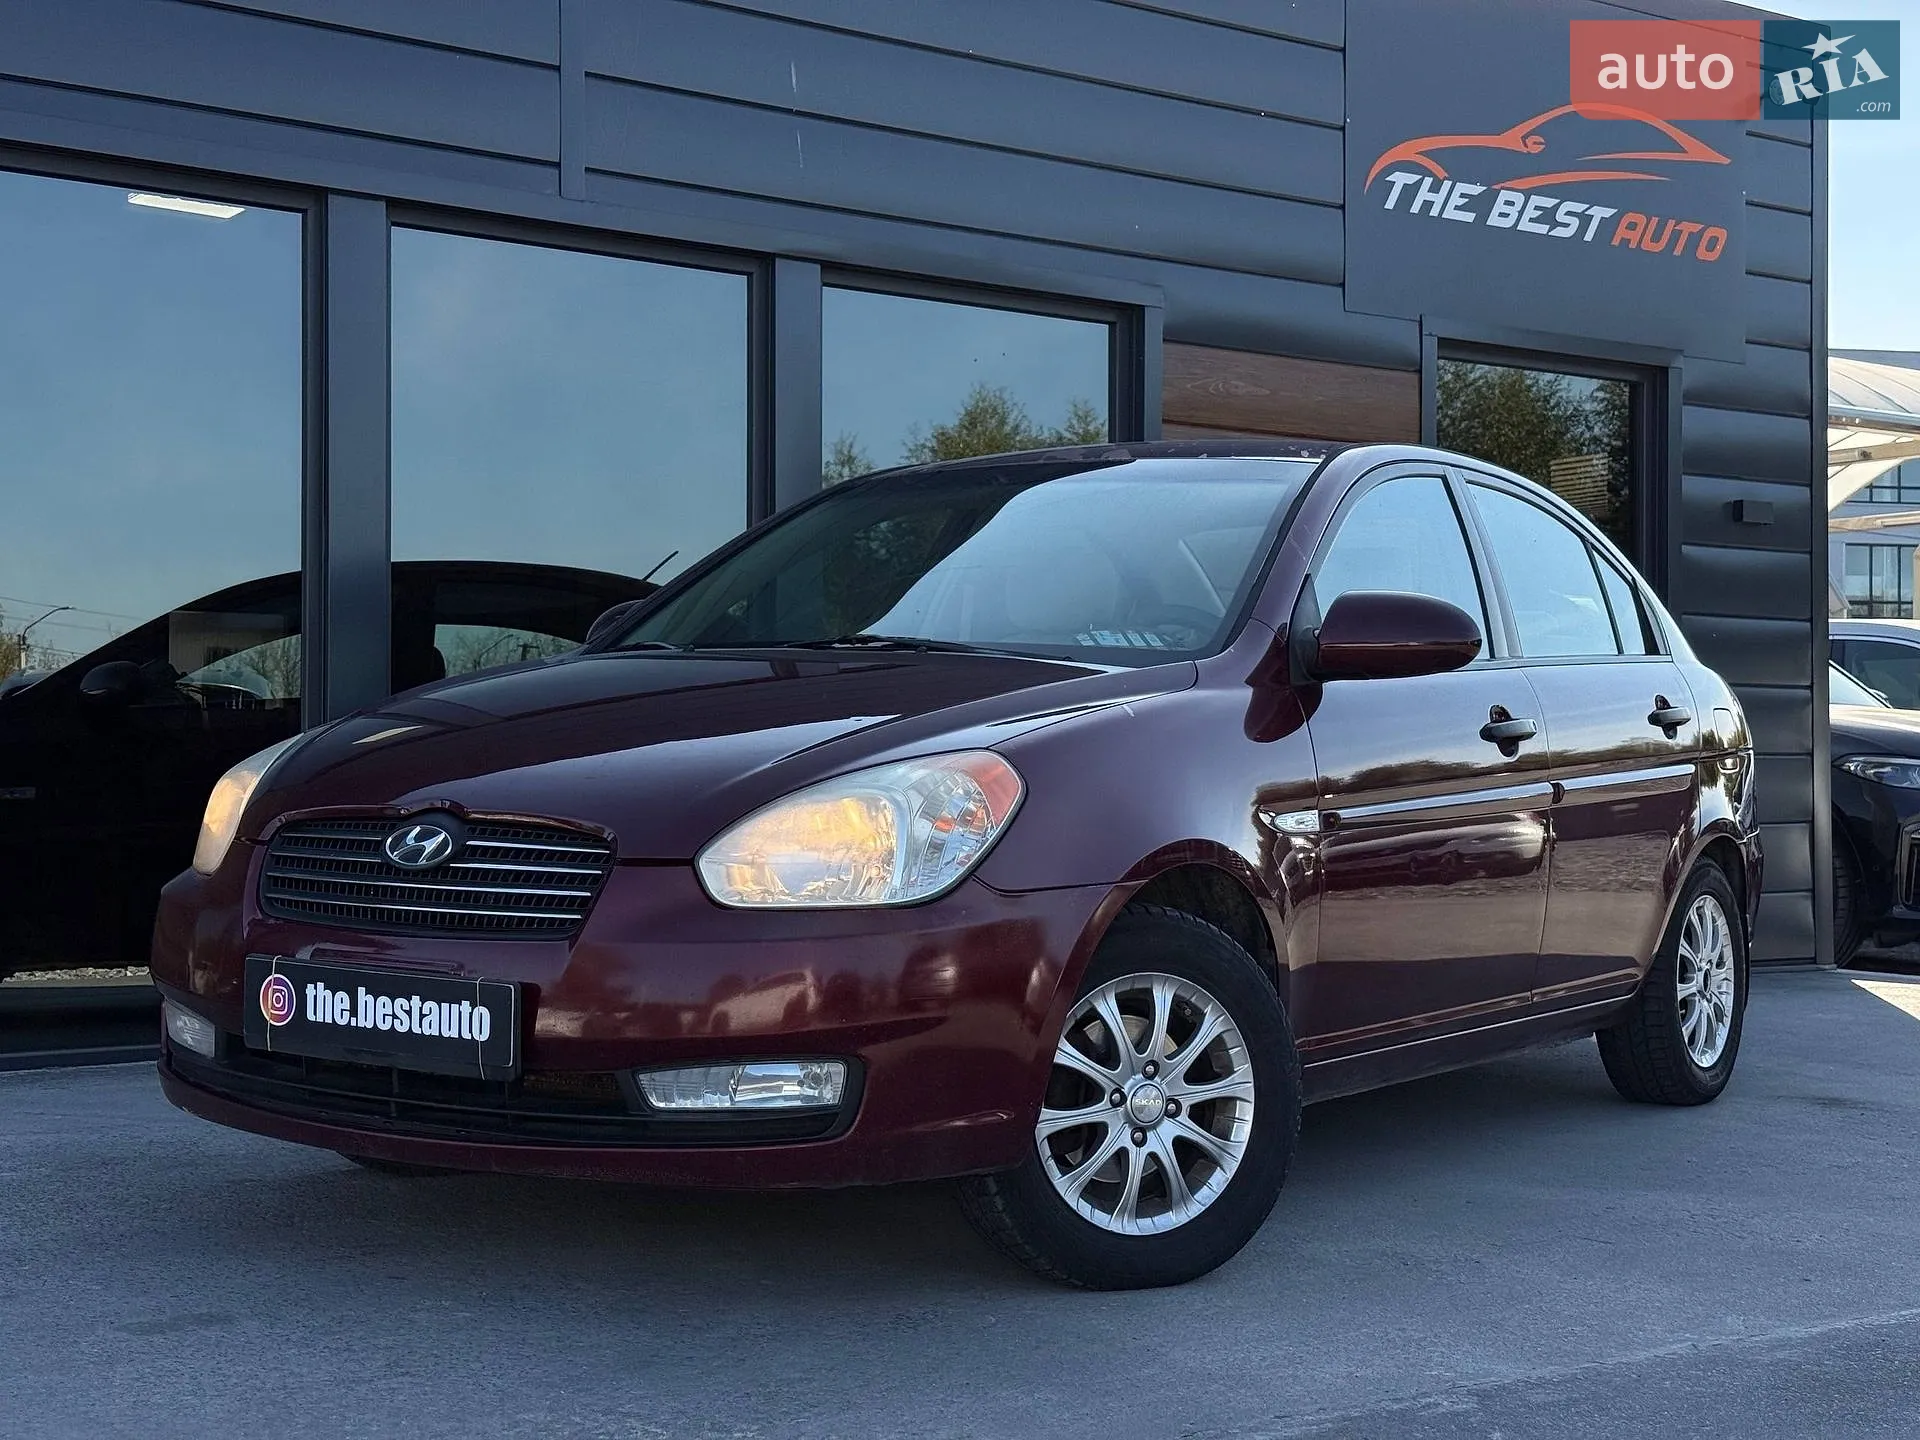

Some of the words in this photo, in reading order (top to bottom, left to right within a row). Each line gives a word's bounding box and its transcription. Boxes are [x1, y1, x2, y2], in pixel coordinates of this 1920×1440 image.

[1383, 171, 1486, 222] THE
[1486, 190, 1617, 241] BEST
[1612, 213, 1728, 261] AUTO
[305, 982, 490, 1041] the.bestauto
